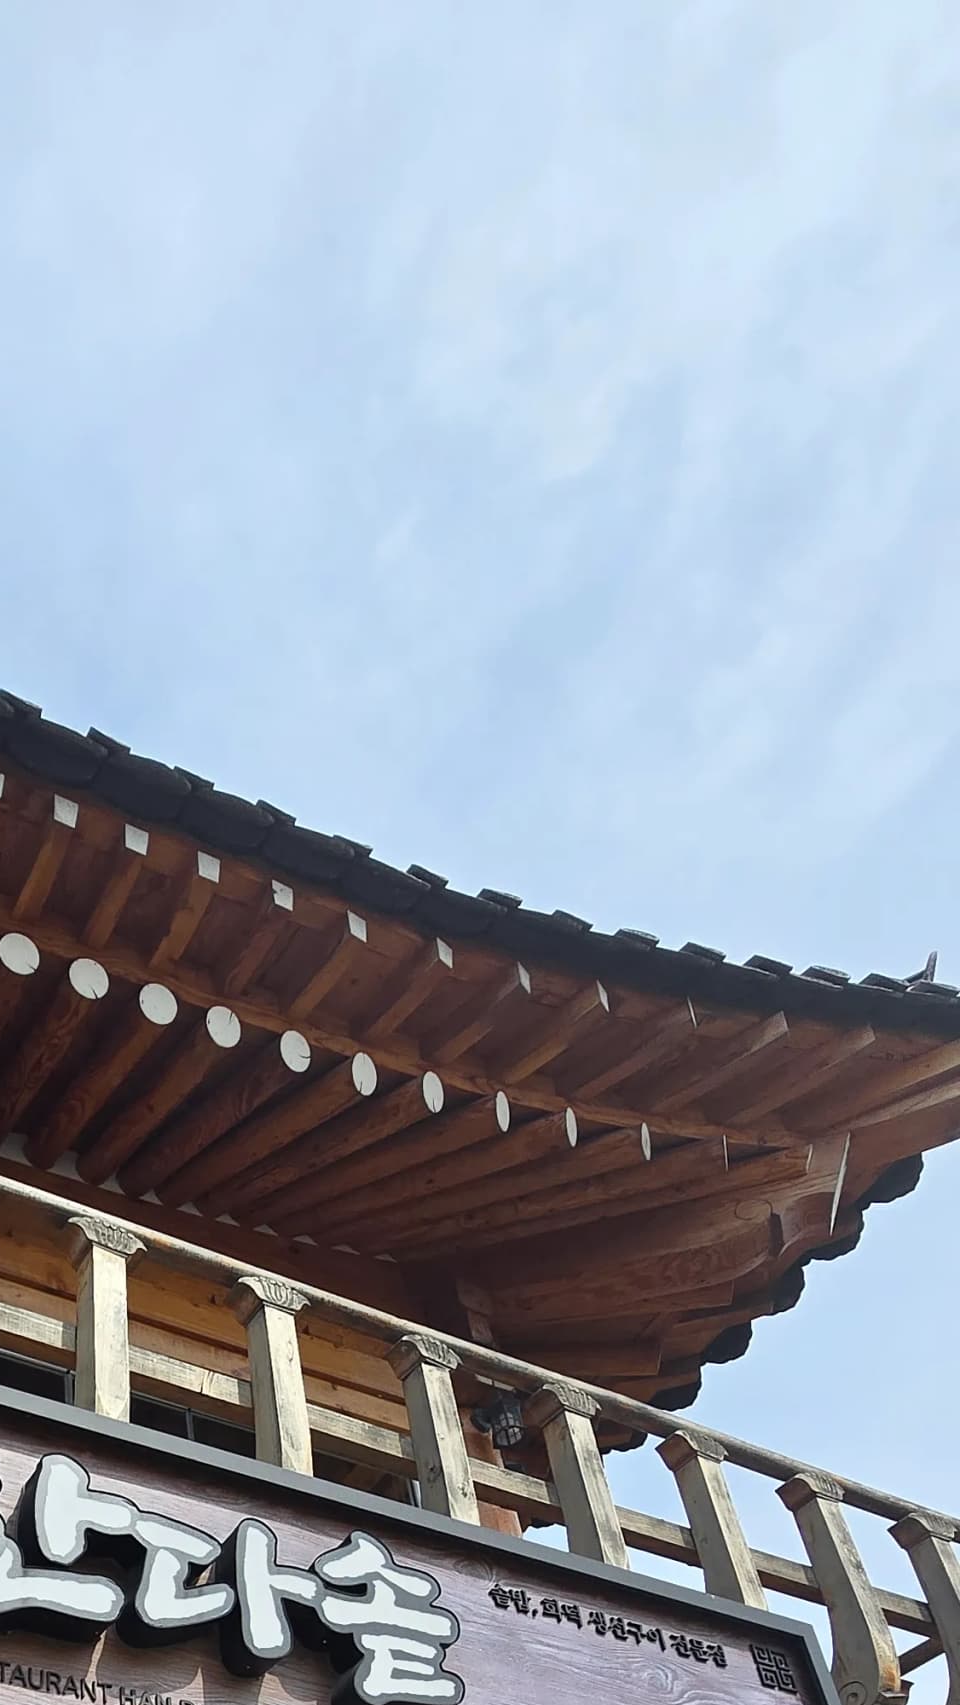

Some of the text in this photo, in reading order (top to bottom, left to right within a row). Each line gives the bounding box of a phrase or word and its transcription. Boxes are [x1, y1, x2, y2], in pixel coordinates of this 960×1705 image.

[540, 1598, 583, 1630] 화덕
[588, 1610, 666, 1652] 생선구이
[669, 1634, 728, 1669] 전문점
